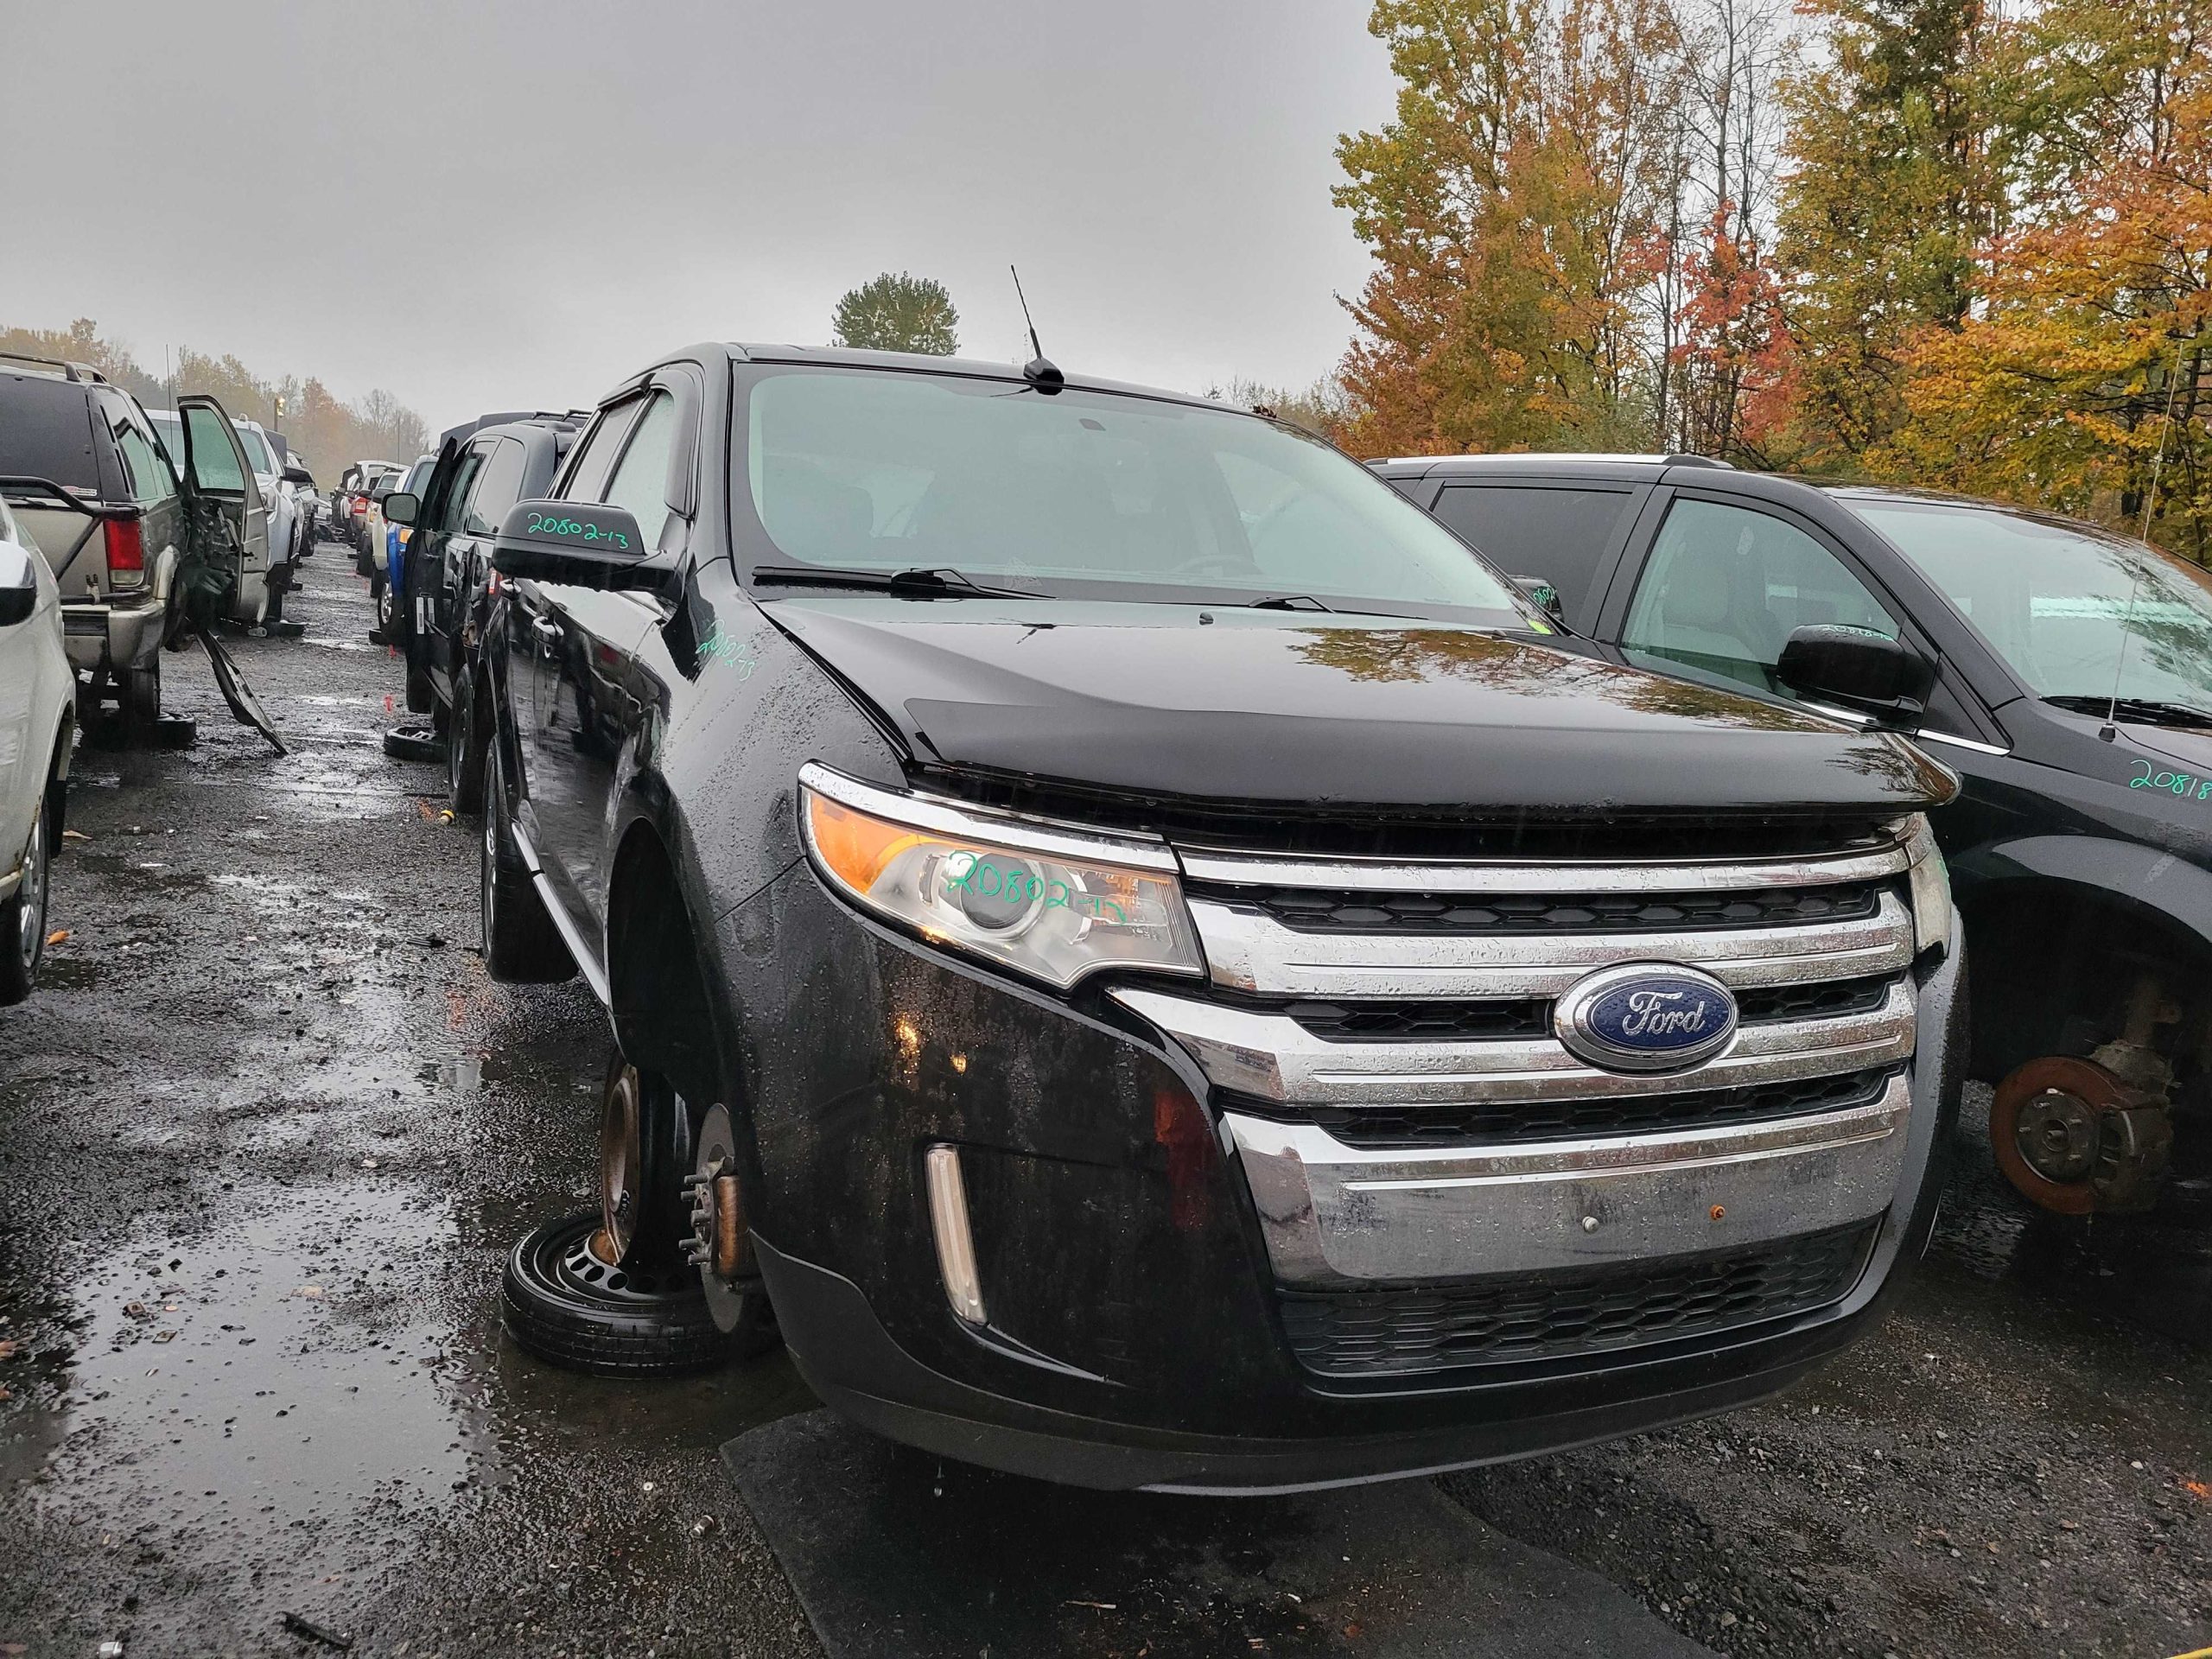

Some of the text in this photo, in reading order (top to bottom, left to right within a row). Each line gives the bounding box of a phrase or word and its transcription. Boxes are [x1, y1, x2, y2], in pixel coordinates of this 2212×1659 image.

[528, 512, 629, 549] 20802-13
[2130, 759, 2212, 800] 20818
[1622, 991, 1706, 1036] Ford
